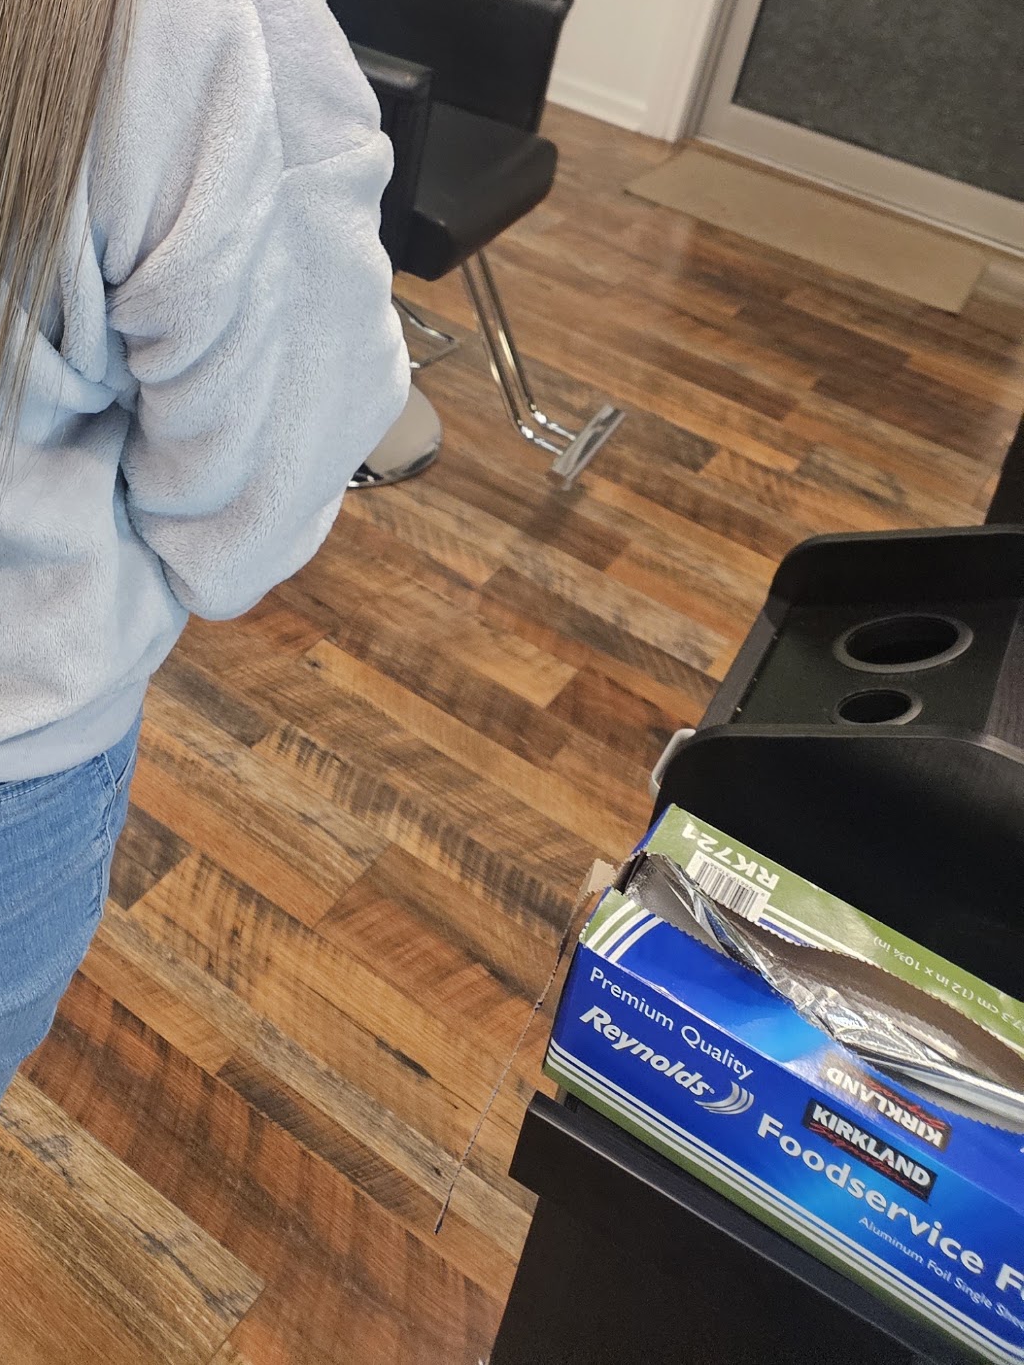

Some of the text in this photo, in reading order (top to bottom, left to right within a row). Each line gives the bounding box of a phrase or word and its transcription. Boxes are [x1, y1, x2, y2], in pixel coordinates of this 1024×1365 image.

[682, 823, 780, 891] RK721
[873, 936, 891, 950] in)
[924, 966, 934, 977] x
[935, 973, 950, 987] in
[589, 966, 754, 1081] Premium Quality
[951, 982, 975, 1001] (12
[977, 996, 999, 1014] cm
[579, 1005, 706, 1096] Reynolds
[826, 1067, 943, 1148] KIRKLAND
[812, 1104, 931, 1186] KIRKLAND
[757, 1113, 984, 1274] Foodservice
[995, 1263, 1024, 1301] F
[858, 1216, 925, 1265] Aluminum
[927, 1259, 952, 1282] Foil
[954, 1277, 993, 1310] Single
